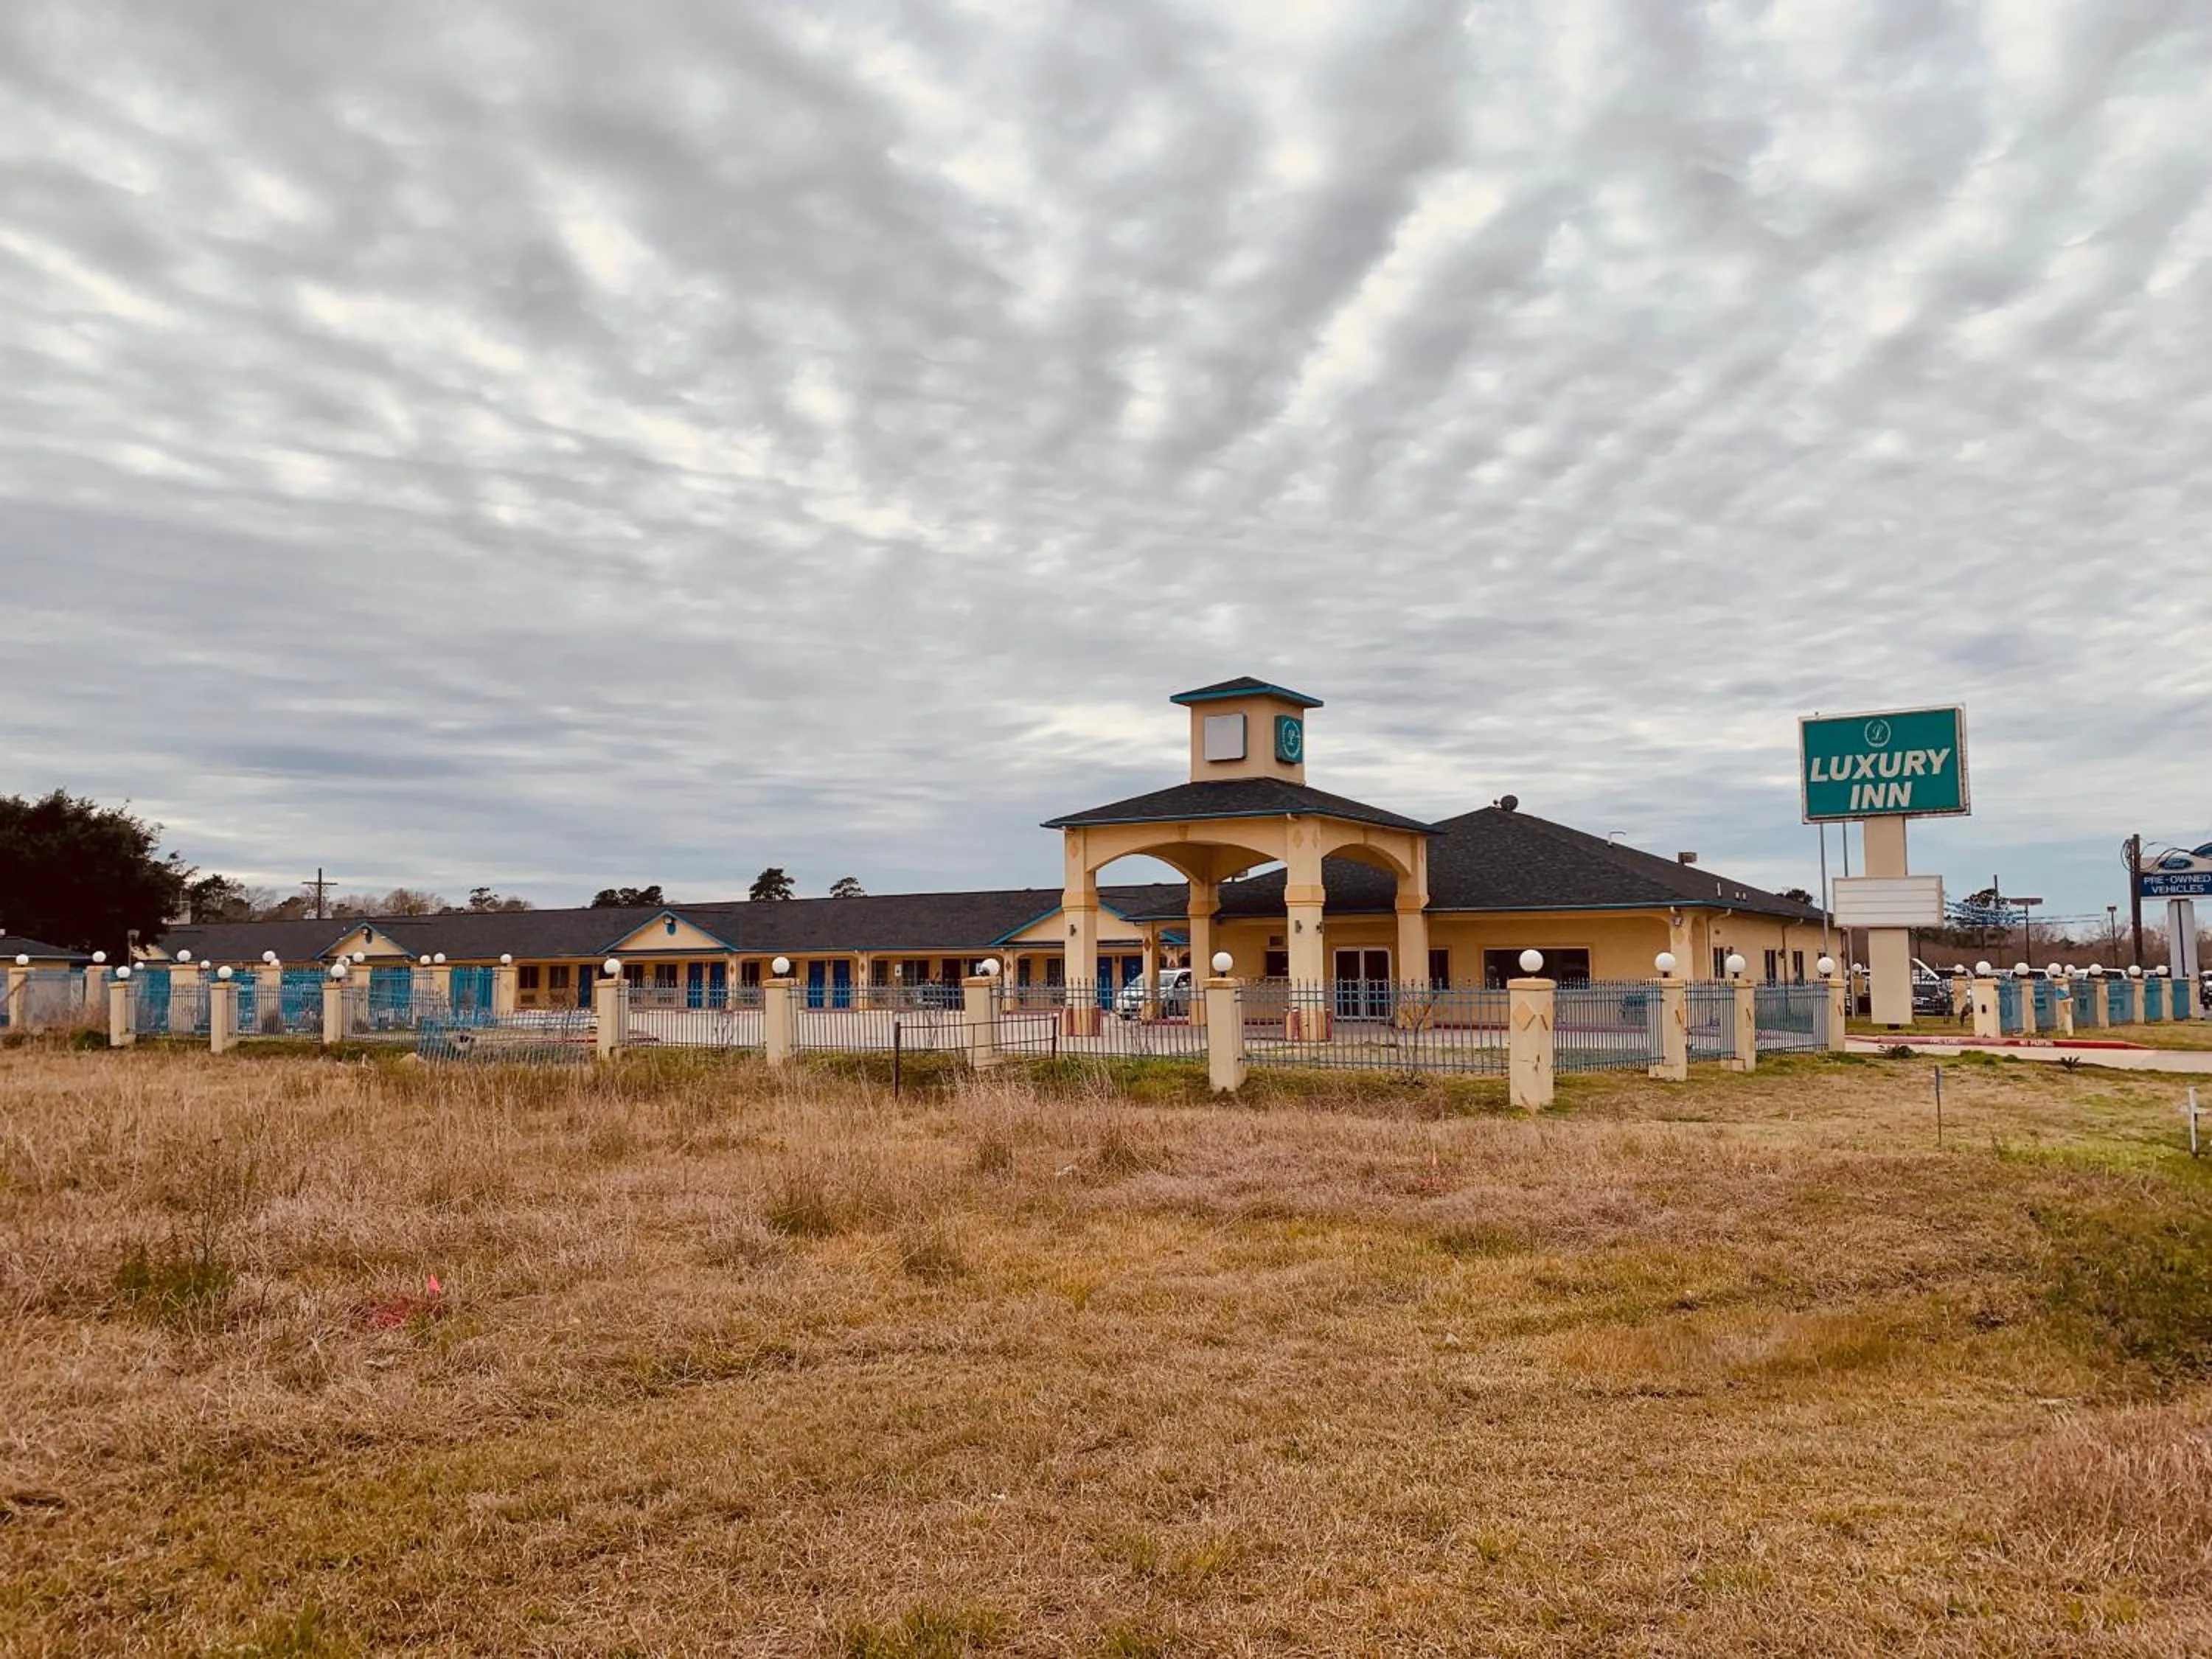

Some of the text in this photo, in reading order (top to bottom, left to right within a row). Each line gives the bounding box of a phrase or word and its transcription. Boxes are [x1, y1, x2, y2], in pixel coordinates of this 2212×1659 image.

[1809, 748, 1951, 782] LUXURY
[1850, 782, 1912, 810] INN
[2152, 885, 2205, 894] VEHICLES
